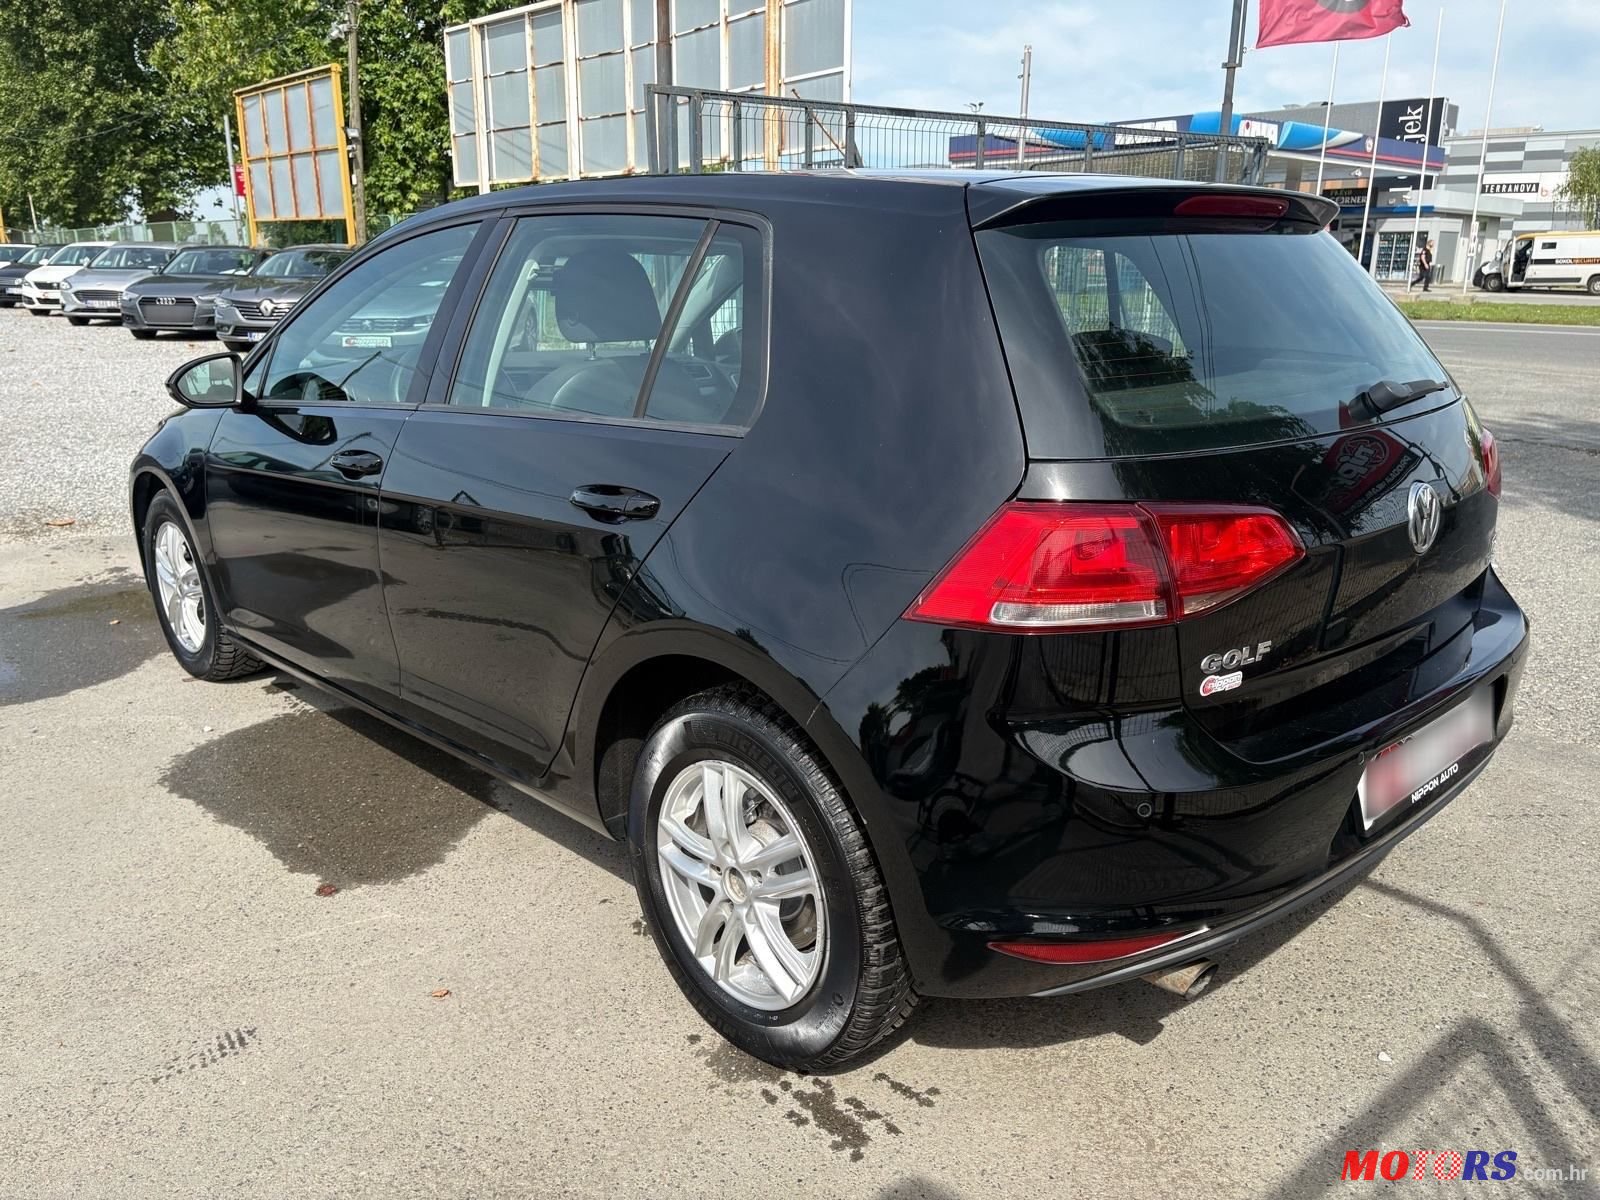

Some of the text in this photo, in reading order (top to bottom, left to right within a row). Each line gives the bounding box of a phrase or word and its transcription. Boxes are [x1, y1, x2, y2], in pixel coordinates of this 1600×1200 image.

[1396, 104, 1427, 144] jek
[1485, 183, 1537, 193] TERRANOVA
[1200, 640, 1272, 675] GOLF
[1411, 763, 1459, 804] NIPPON AUTO
